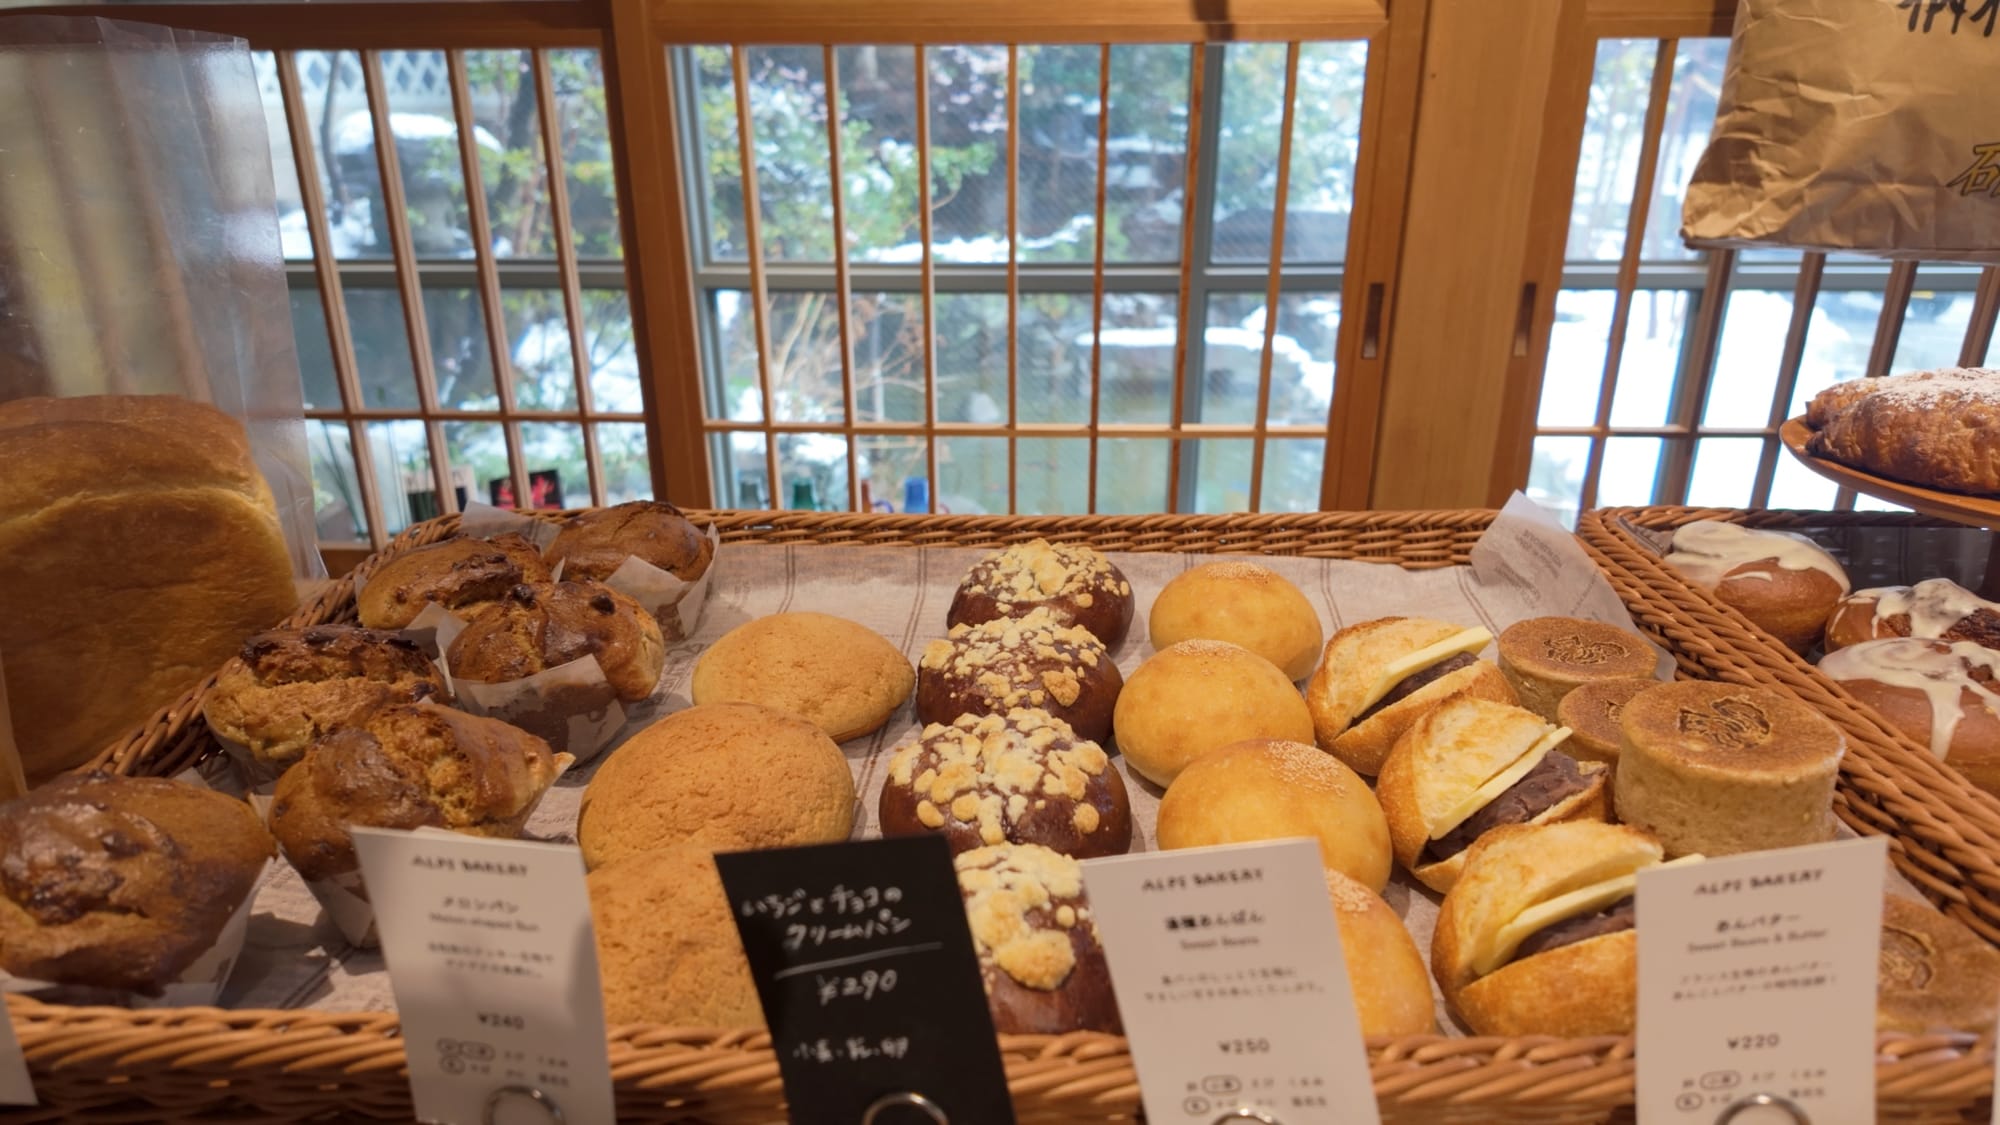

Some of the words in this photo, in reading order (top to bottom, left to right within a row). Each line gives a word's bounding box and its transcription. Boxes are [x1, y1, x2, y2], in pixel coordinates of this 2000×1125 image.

[462, 858, 528, 876] BAKERY
[1193, 868, 1264, 887] BAKERY
[1750, 869, 1826, 888] BAKERY
[442, 896, 519, 913] メロンパン
[784, 908, 912, 950] クリームパン
[1716, 912, 1802, 933] あんバター
[1787, 928, 1829, 942] Butter
[816, 969, 898, 1006] ¥290
[477, 1011, 526, 1030] ¥240
[1218, 1038, 1271, 1056] ¥250
[1727, 1032, 1781, 1051] ¥220
